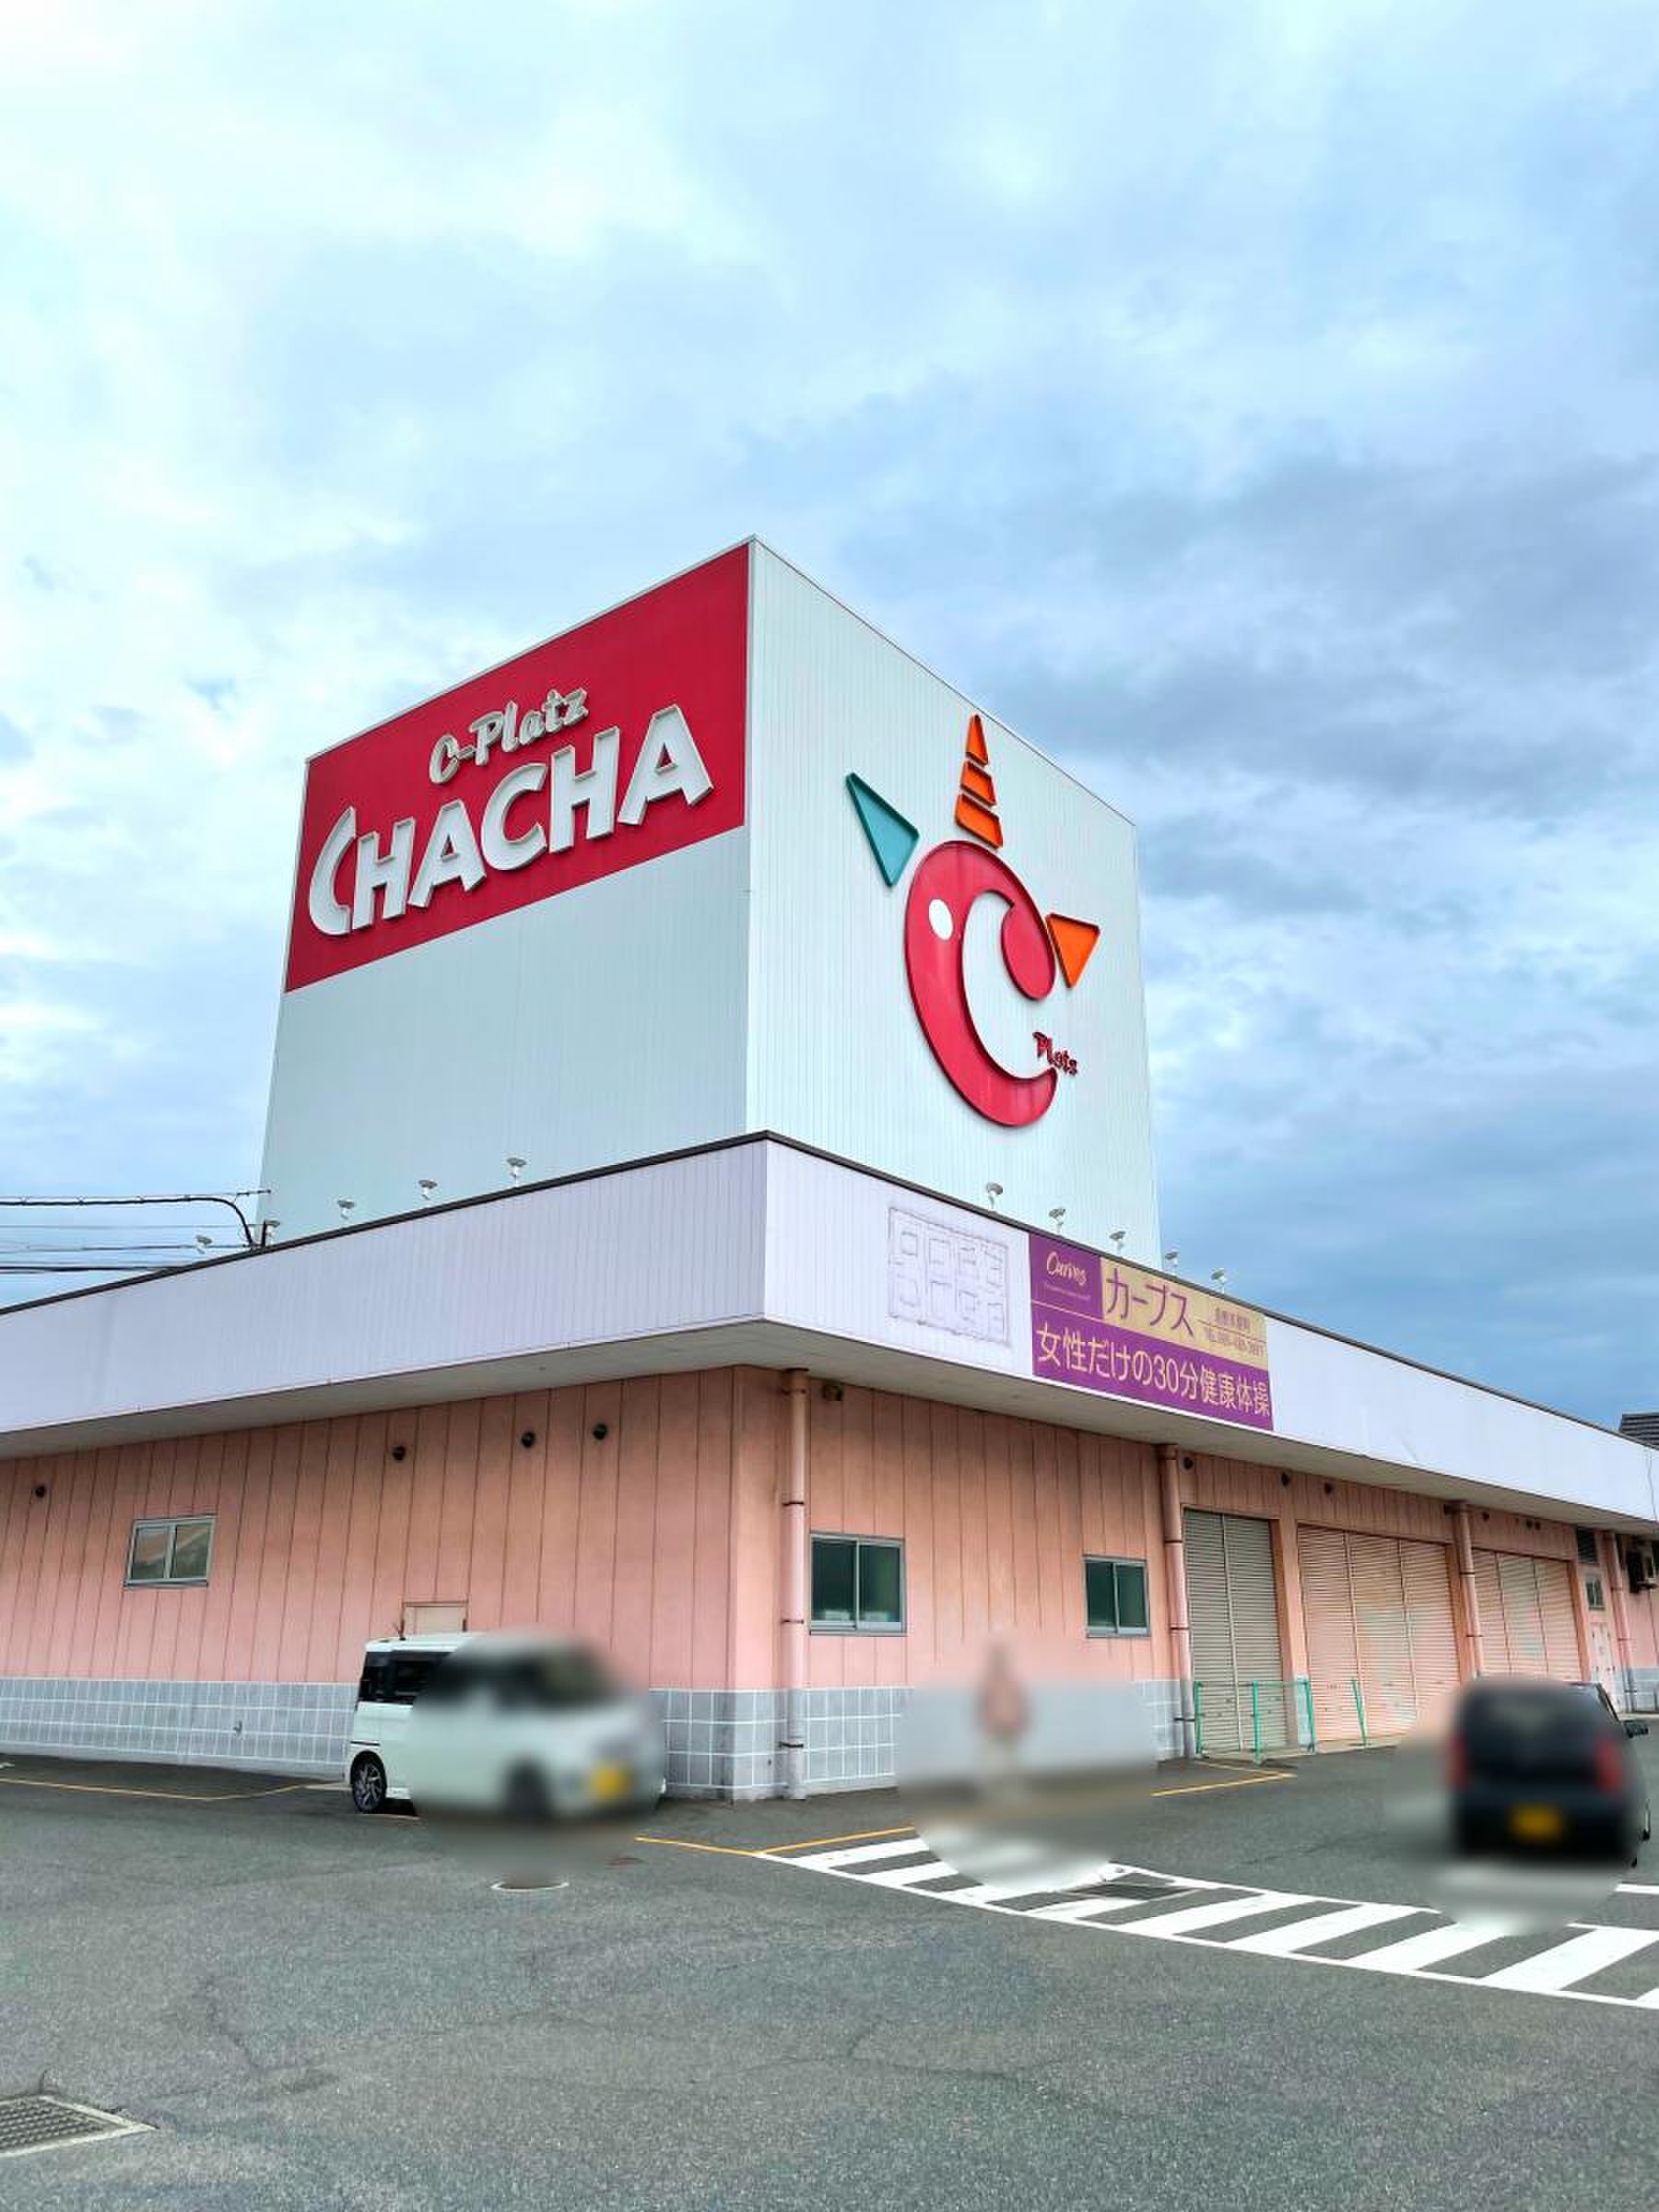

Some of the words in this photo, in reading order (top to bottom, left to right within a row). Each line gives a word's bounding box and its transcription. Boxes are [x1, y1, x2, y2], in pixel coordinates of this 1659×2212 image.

[429, 688, 589, 783] C-Platz
[309, 703, 714, 935] CHACHA
[1036, 1321, 1270, 1417] 女性だけの30分健康体操
